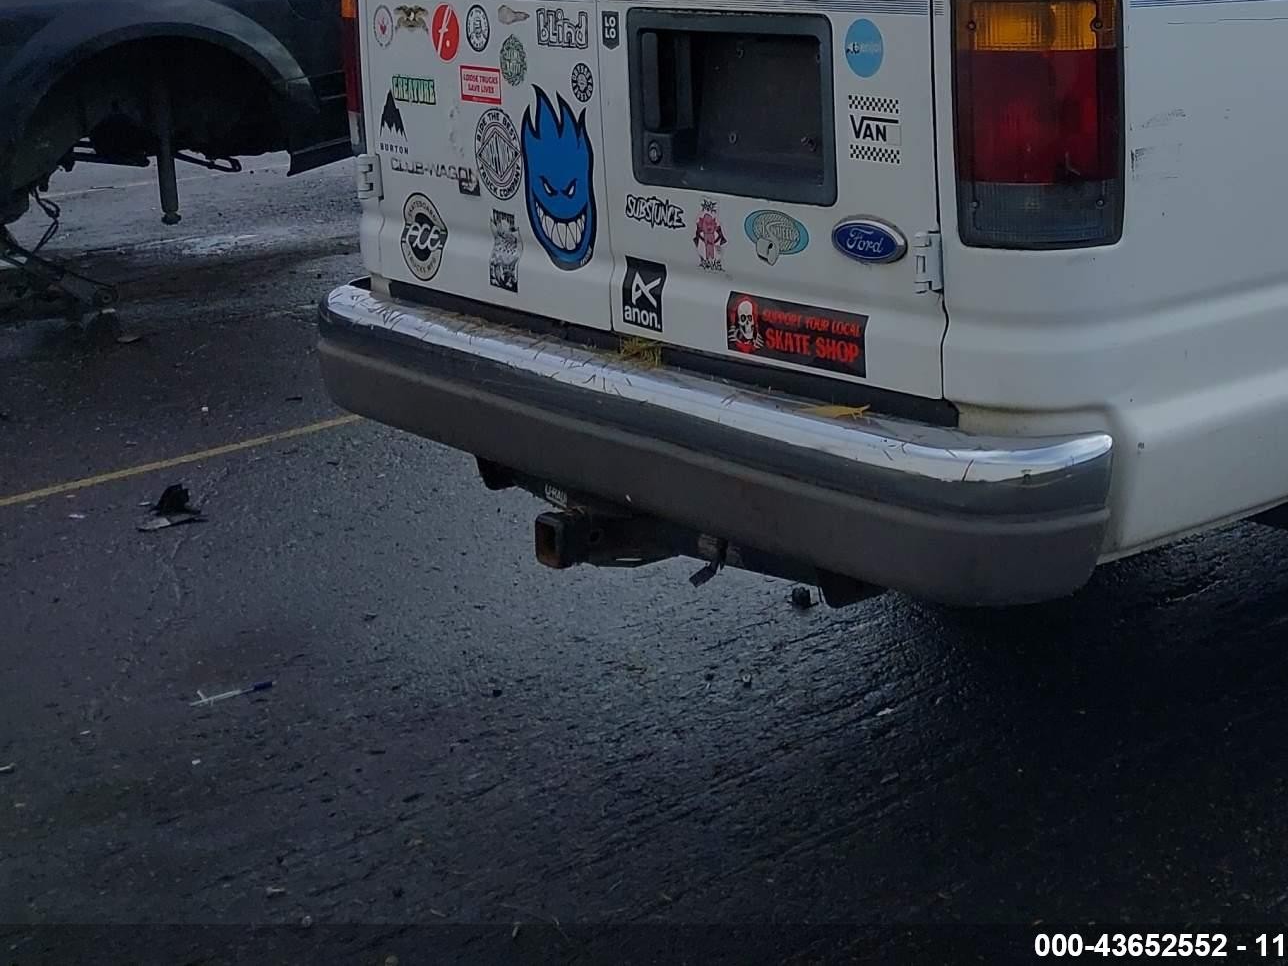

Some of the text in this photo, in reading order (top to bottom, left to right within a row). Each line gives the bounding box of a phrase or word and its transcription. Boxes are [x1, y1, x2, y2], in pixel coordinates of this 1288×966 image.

[604, 16, 616, 27] LO
[604, 27, 616, 39] LO
[479, 75, 498, 85] TRUCKS
[391, 75, 436, 105] CREATURE
[487, 112, 500, 122] THE
[380, 142, 409, 155] BURTON
[846, 228, 884, 254] Ford
[624, 305, 662, 330] anon.
[762, 308, 861, 338] SUPPORT YOUR LOCAL
[765, 327, 860, 363] SKATE SHOP
